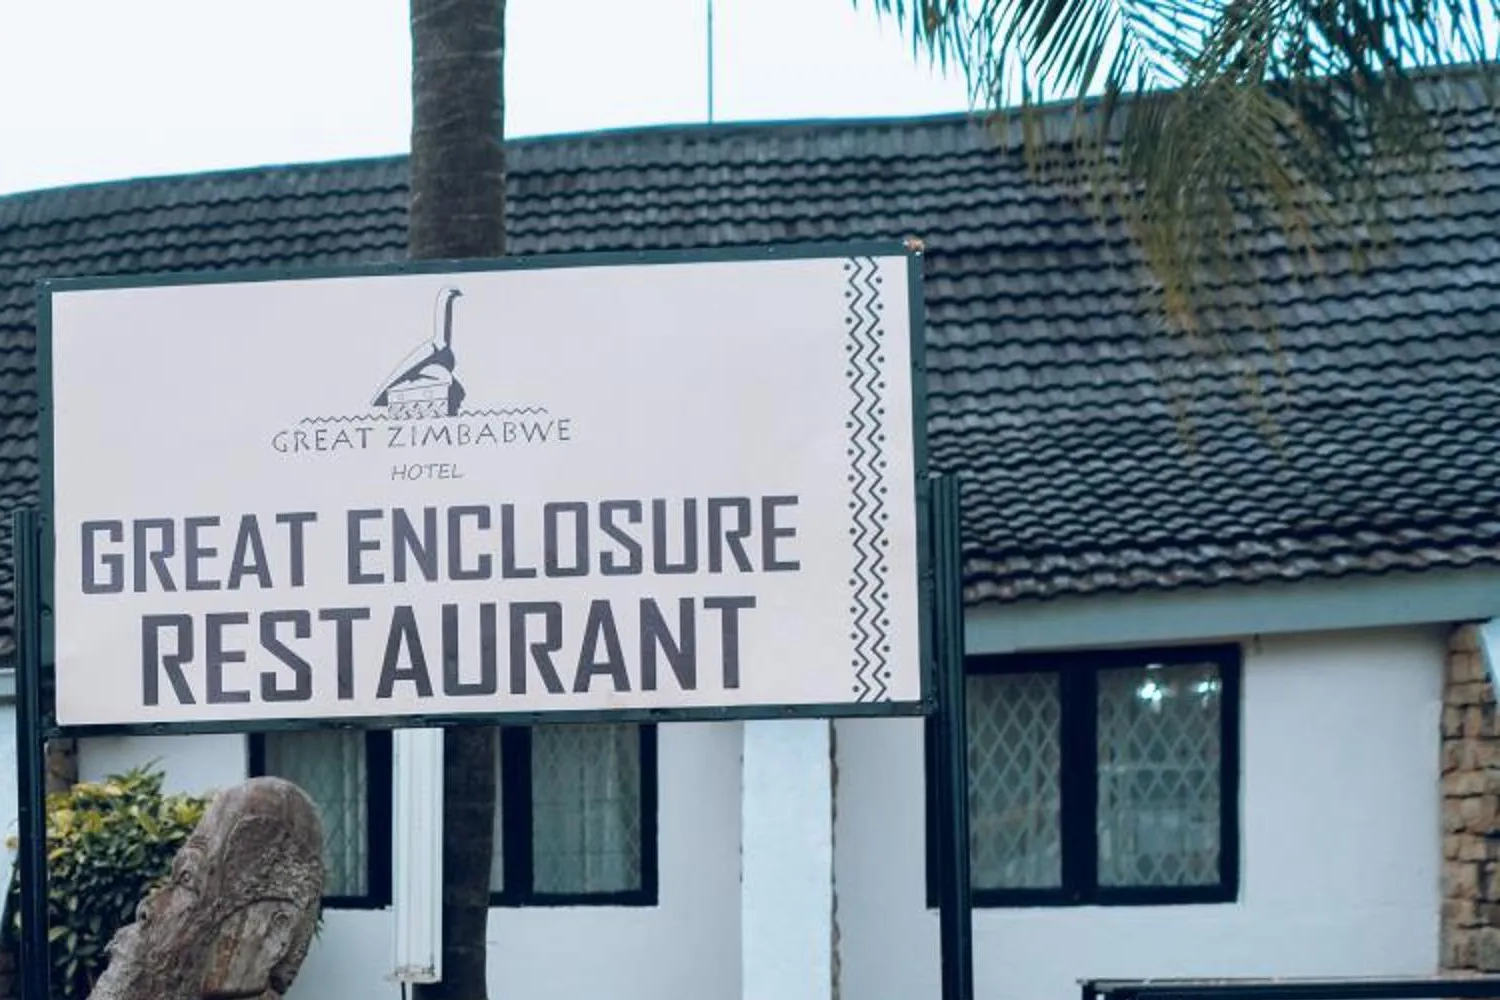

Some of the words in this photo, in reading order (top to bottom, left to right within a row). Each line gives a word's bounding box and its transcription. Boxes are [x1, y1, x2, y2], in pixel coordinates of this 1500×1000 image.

[271, 428, 373, 453] GREAT
[388, 419, 571, 448] ZIMBABWE
[391, 463, 464, 481] HOTEL
[81, 511, 318, 595] GREAT
[348, 495, 801, 584] ENCLOSURE
[142, 595, 756, 706] RESTAURANT
